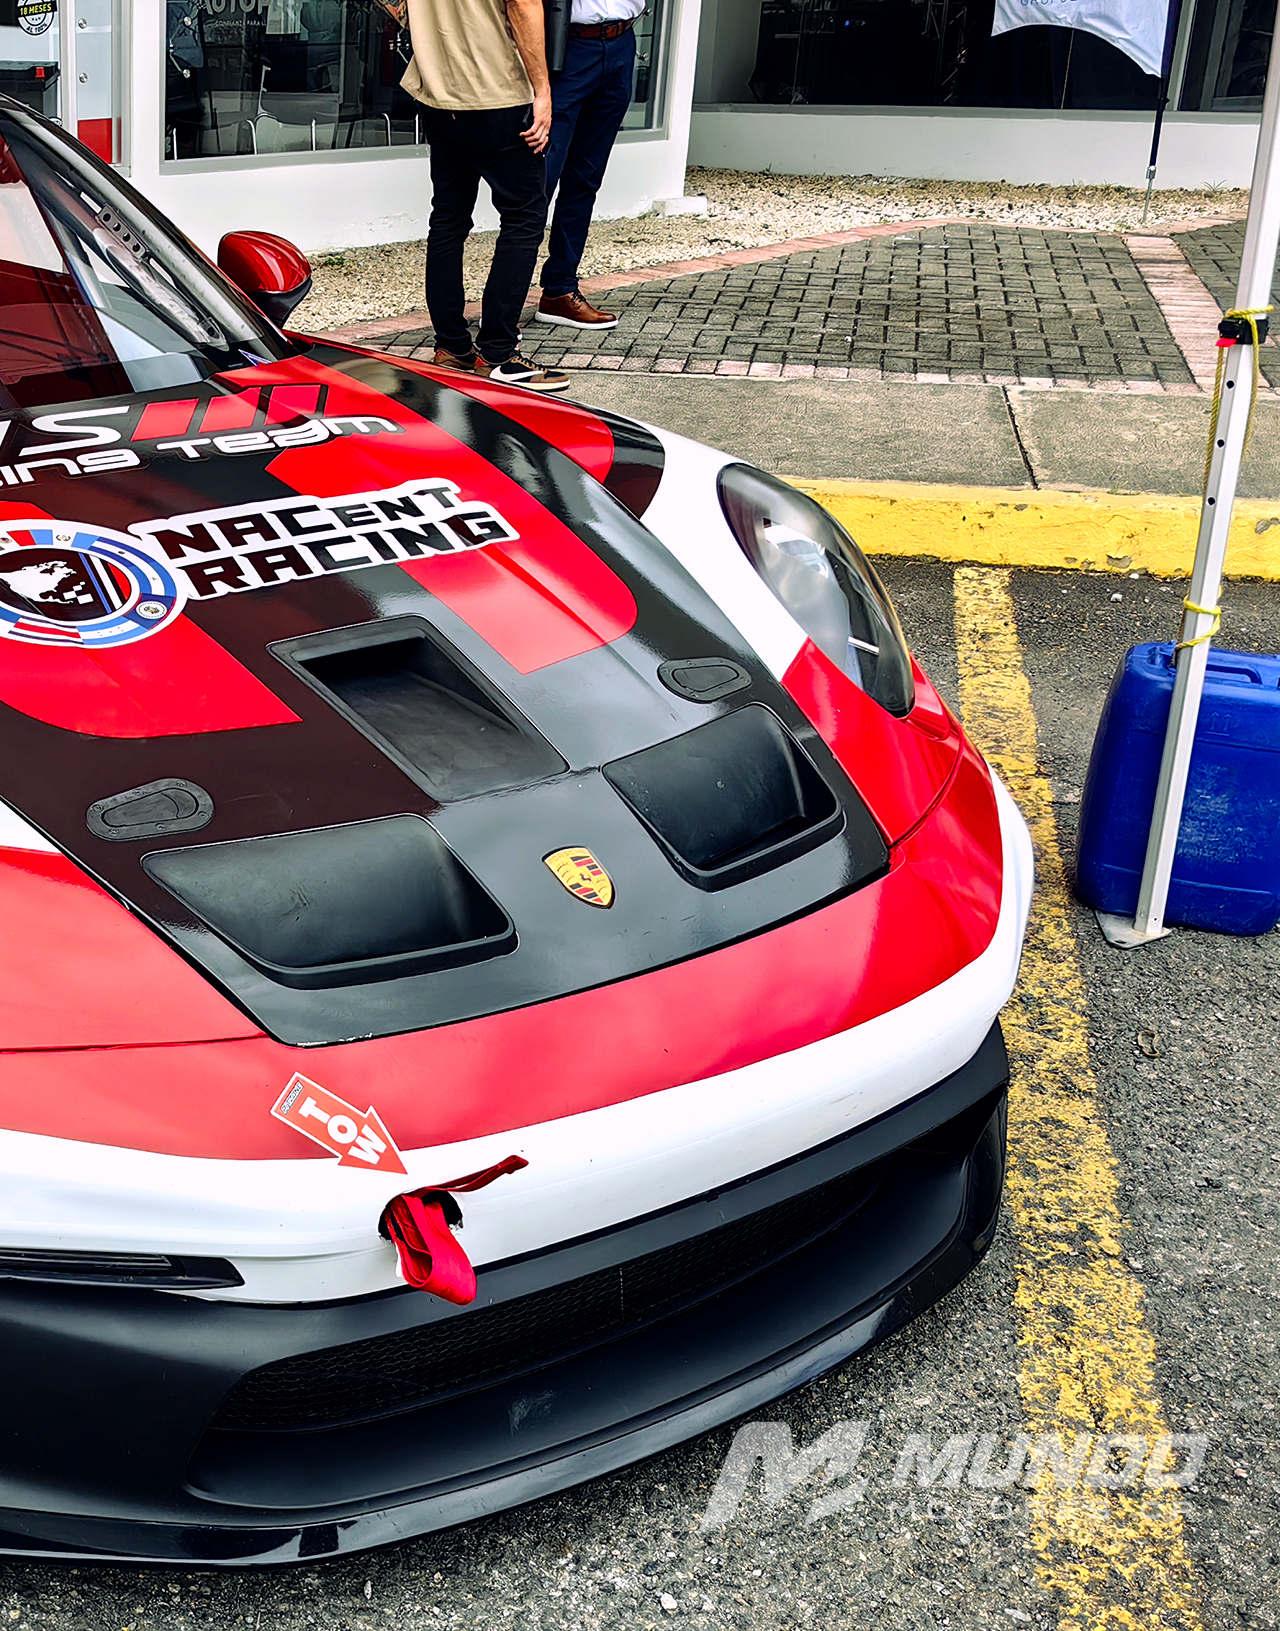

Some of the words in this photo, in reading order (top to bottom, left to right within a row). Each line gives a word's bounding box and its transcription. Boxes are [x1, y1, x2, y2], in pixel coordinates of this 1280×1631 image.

[19, 7, 28, 16] 18
[28, 3, 52, 15] MESES
[176, 511, 509, 598] RACING
[298, 1096, 388, 1165] TOW
